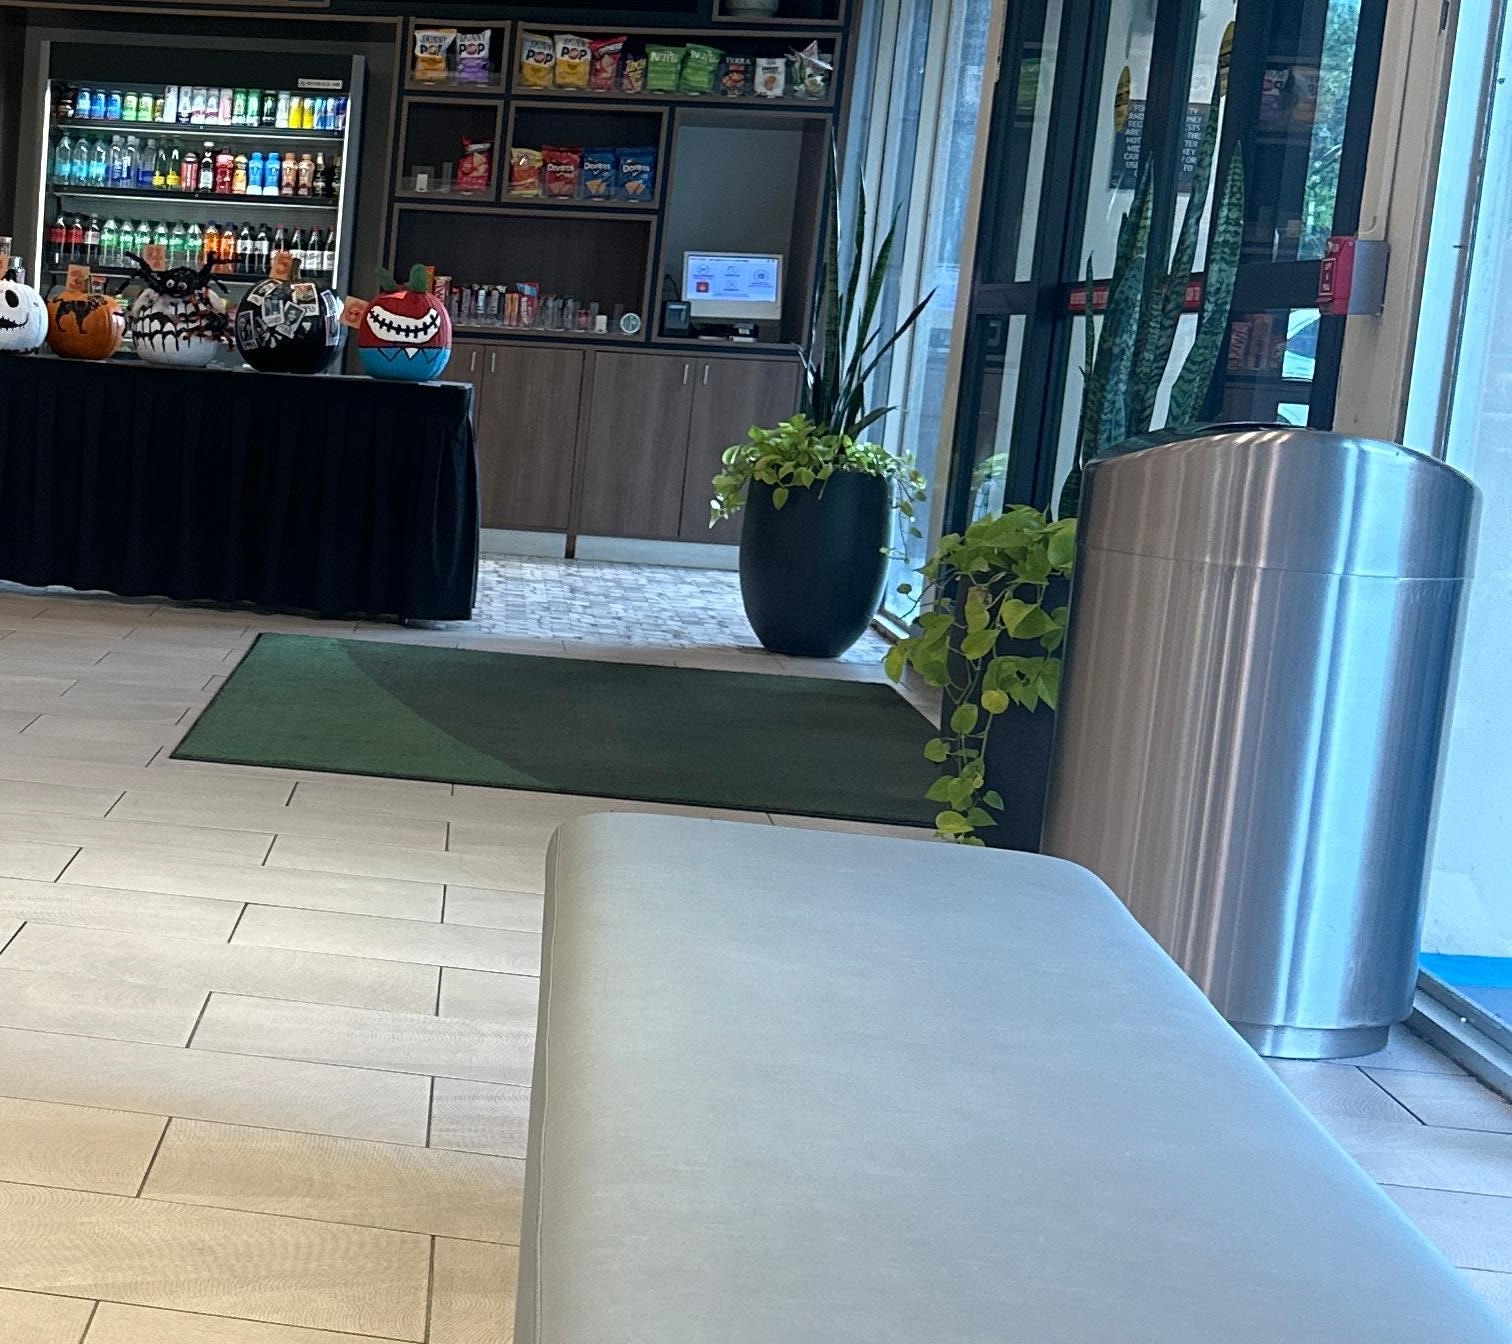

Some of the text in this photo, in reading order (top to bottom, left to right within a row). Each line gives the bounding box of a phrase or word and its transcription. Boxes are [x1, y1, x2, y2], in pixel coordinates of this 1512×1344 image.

[459, 43, 485, 55] POP
[561, 46, 588, 60] POP
[526, 49, 554, 65] POP
[547, 163, 575, 172] Doritos
[584, 162, 610, 171] Doritos
[623, 164, 650, 173] Doritos
